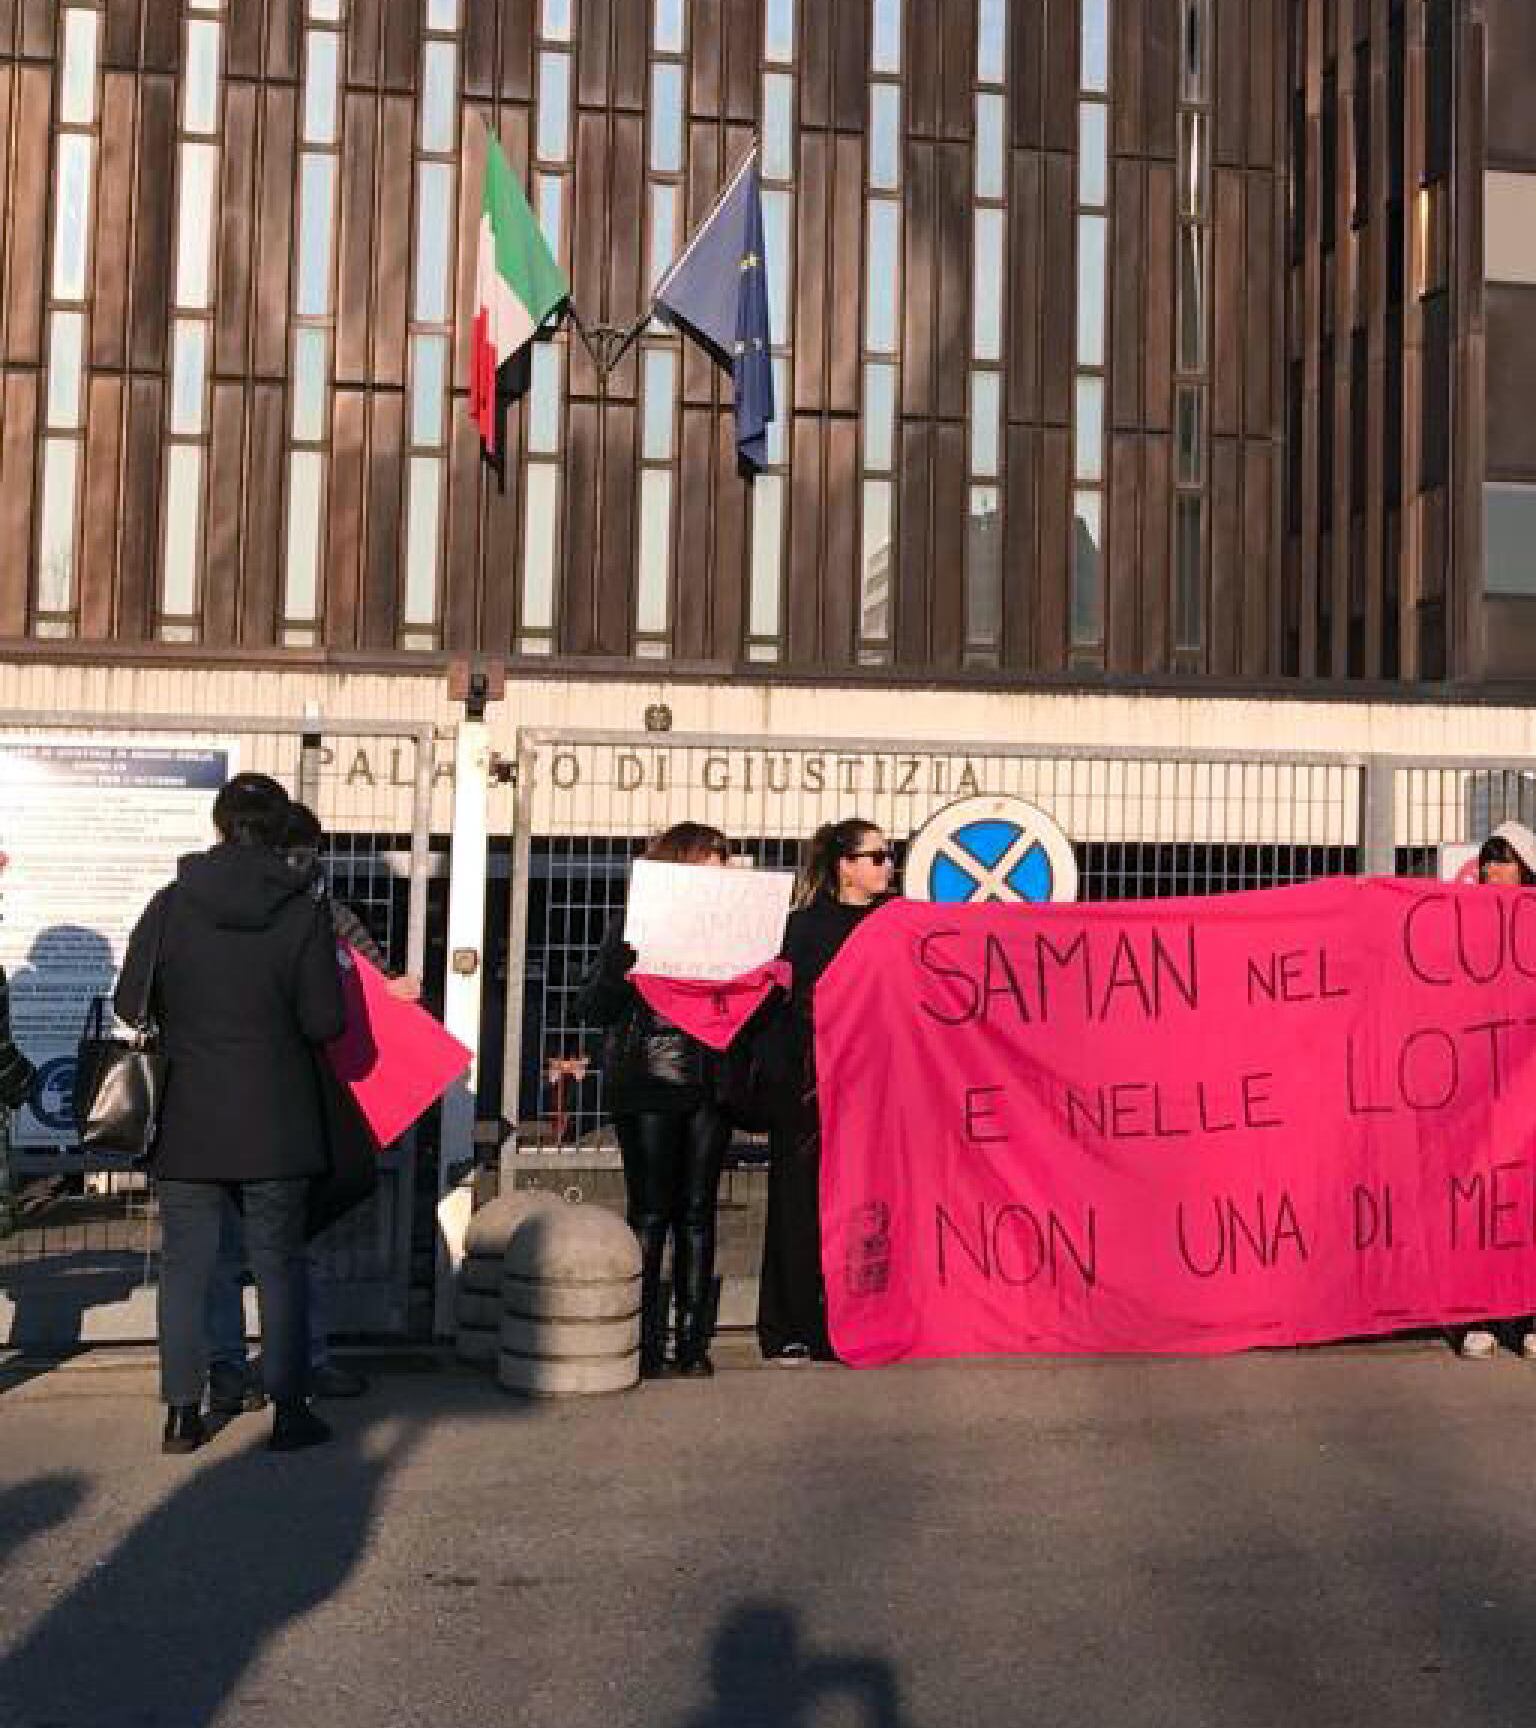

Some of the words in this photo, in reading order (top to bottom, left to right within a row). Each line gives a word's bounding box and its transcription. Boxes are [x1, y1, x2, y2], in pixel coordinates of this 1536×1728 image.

[300, 747, 579, 791] PALAO
[617, 754, 667, 791] DI
[703, 757, 980, 798] GIUSTIZIA
[915, 925, 1199, 1027] SAMAN
[1247, 947, 1351, 1003] NEL
[964, 1085, 1010, 1143] E
[1067, 1071, 1284, 1140] NELLE
[934, 1201, 1097, 1289] NON
[1177, 1191, 1310, 1278] UNA
[1352, 1182, 1404, 1252] DI
